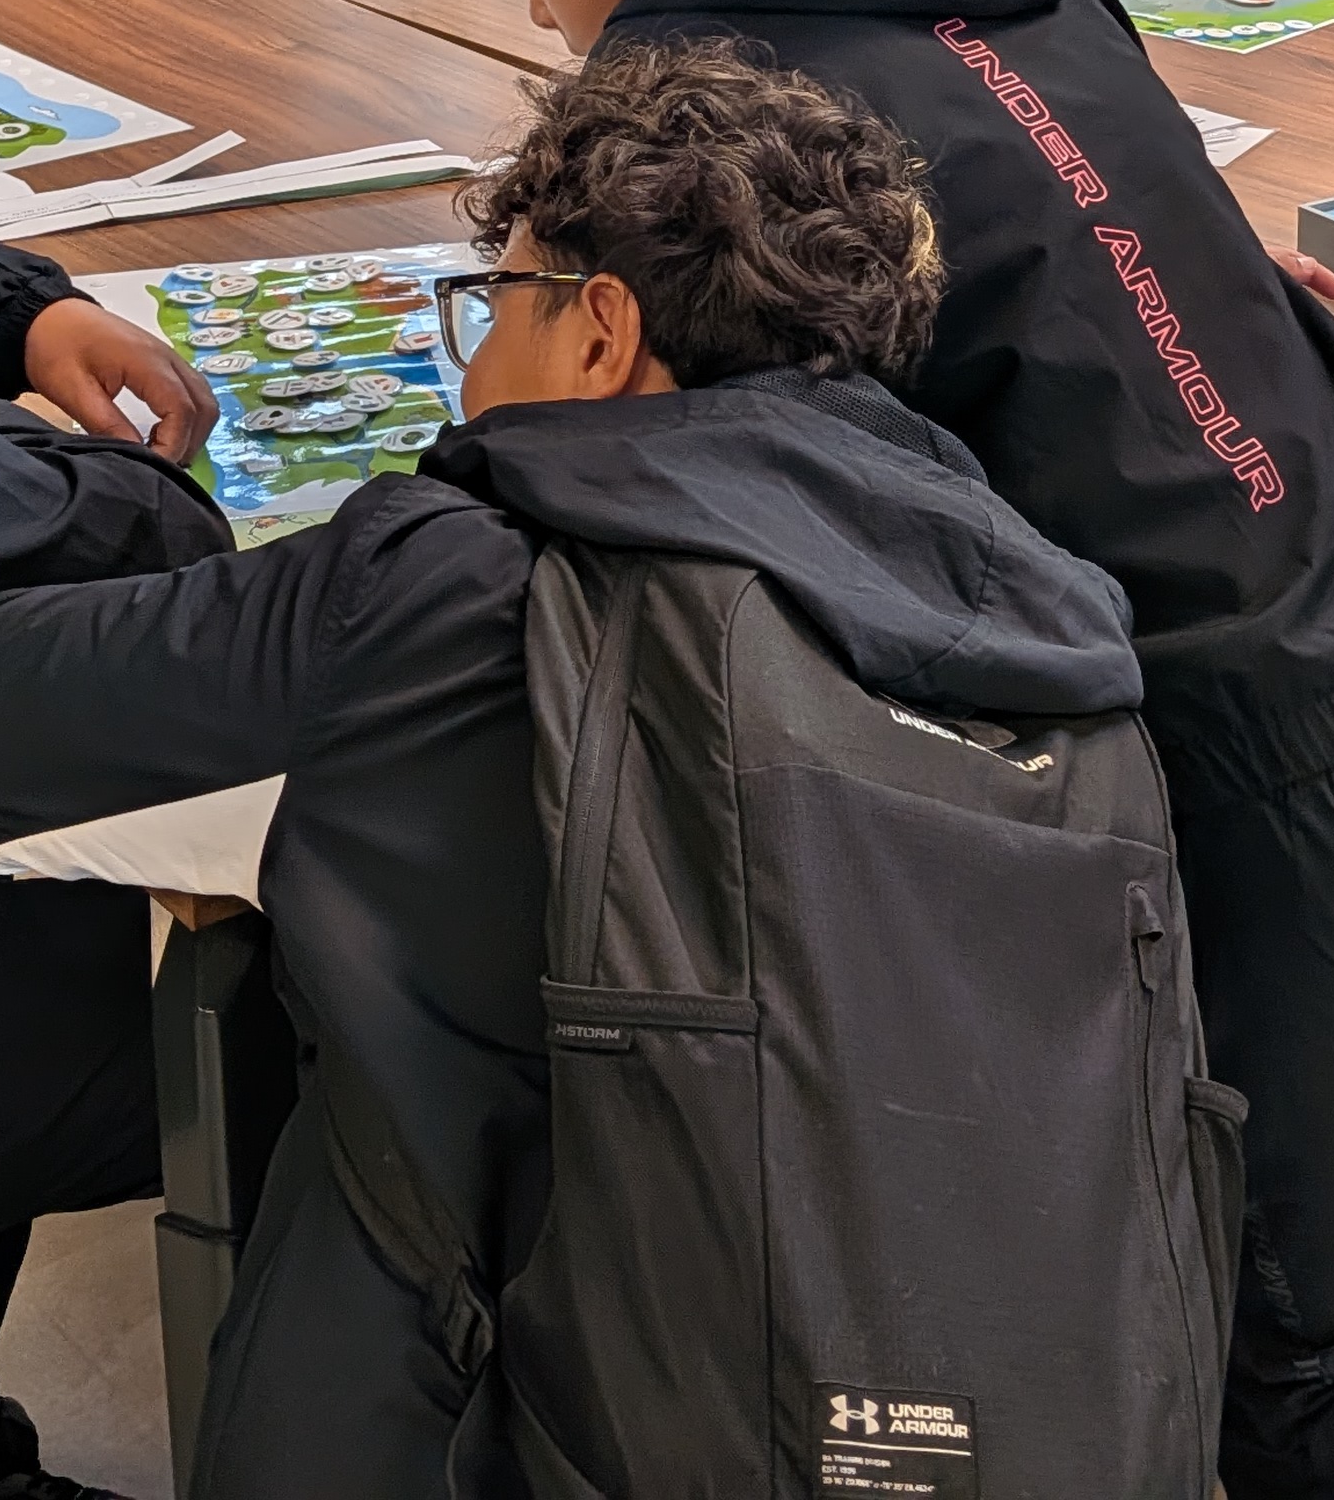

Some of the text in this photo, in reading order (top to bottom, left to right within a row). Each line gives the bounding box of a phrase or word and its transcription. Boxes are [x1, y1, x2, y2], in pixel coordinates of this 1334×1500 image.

[933, 18, 1285, 512] UNDER ARMOUR
[888, 1404, 954, 1421] UNDER
[888, 1420, 969, 1438] ARMOUR
